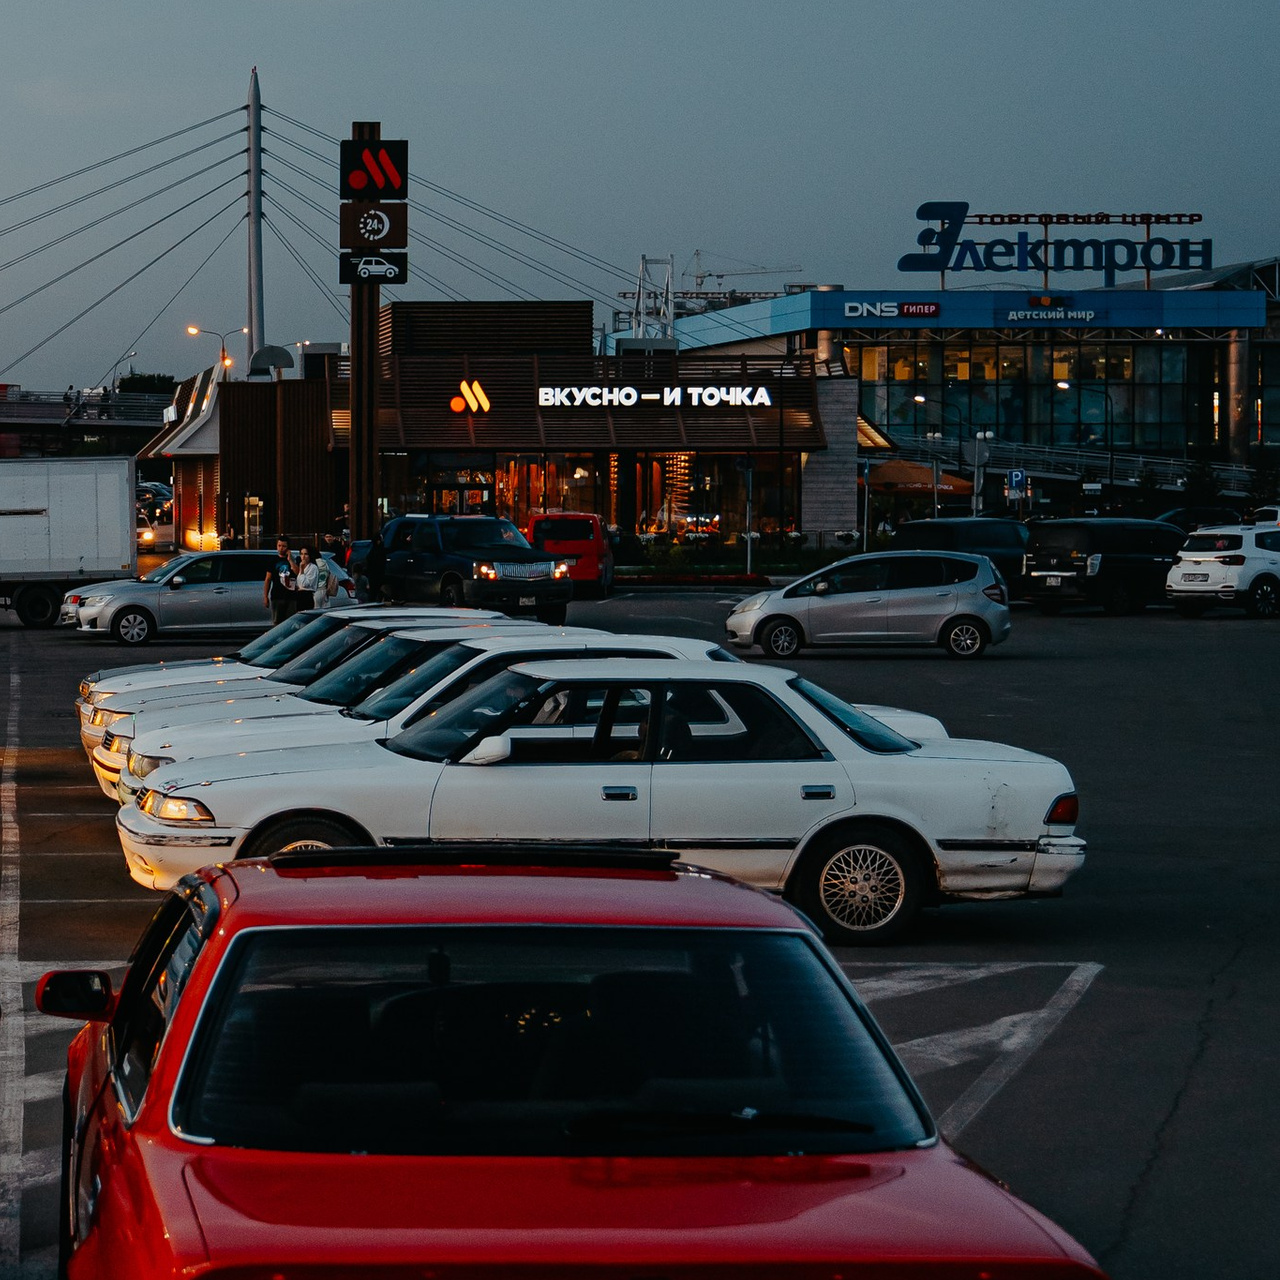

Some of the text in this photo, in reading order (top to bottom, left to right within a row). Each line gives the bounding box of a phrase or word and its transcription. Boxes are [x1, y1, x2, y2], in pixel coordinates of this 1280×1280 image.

[974, 212, 1203, 227] ТОРГОВЫЙ ЦЕНТР
[897, 201, 1213, 288] Электрон
[844, 301, 900, 317] DNS
[903, 304, 937, 314] ГИПЕР
[1007, 308, 1095, 322] детский мир
[538, 386, 638, 407] ВКУСНО
[686, 386, 772, 407] ТОЧКА
[1012, 471, 1022, 487] P
